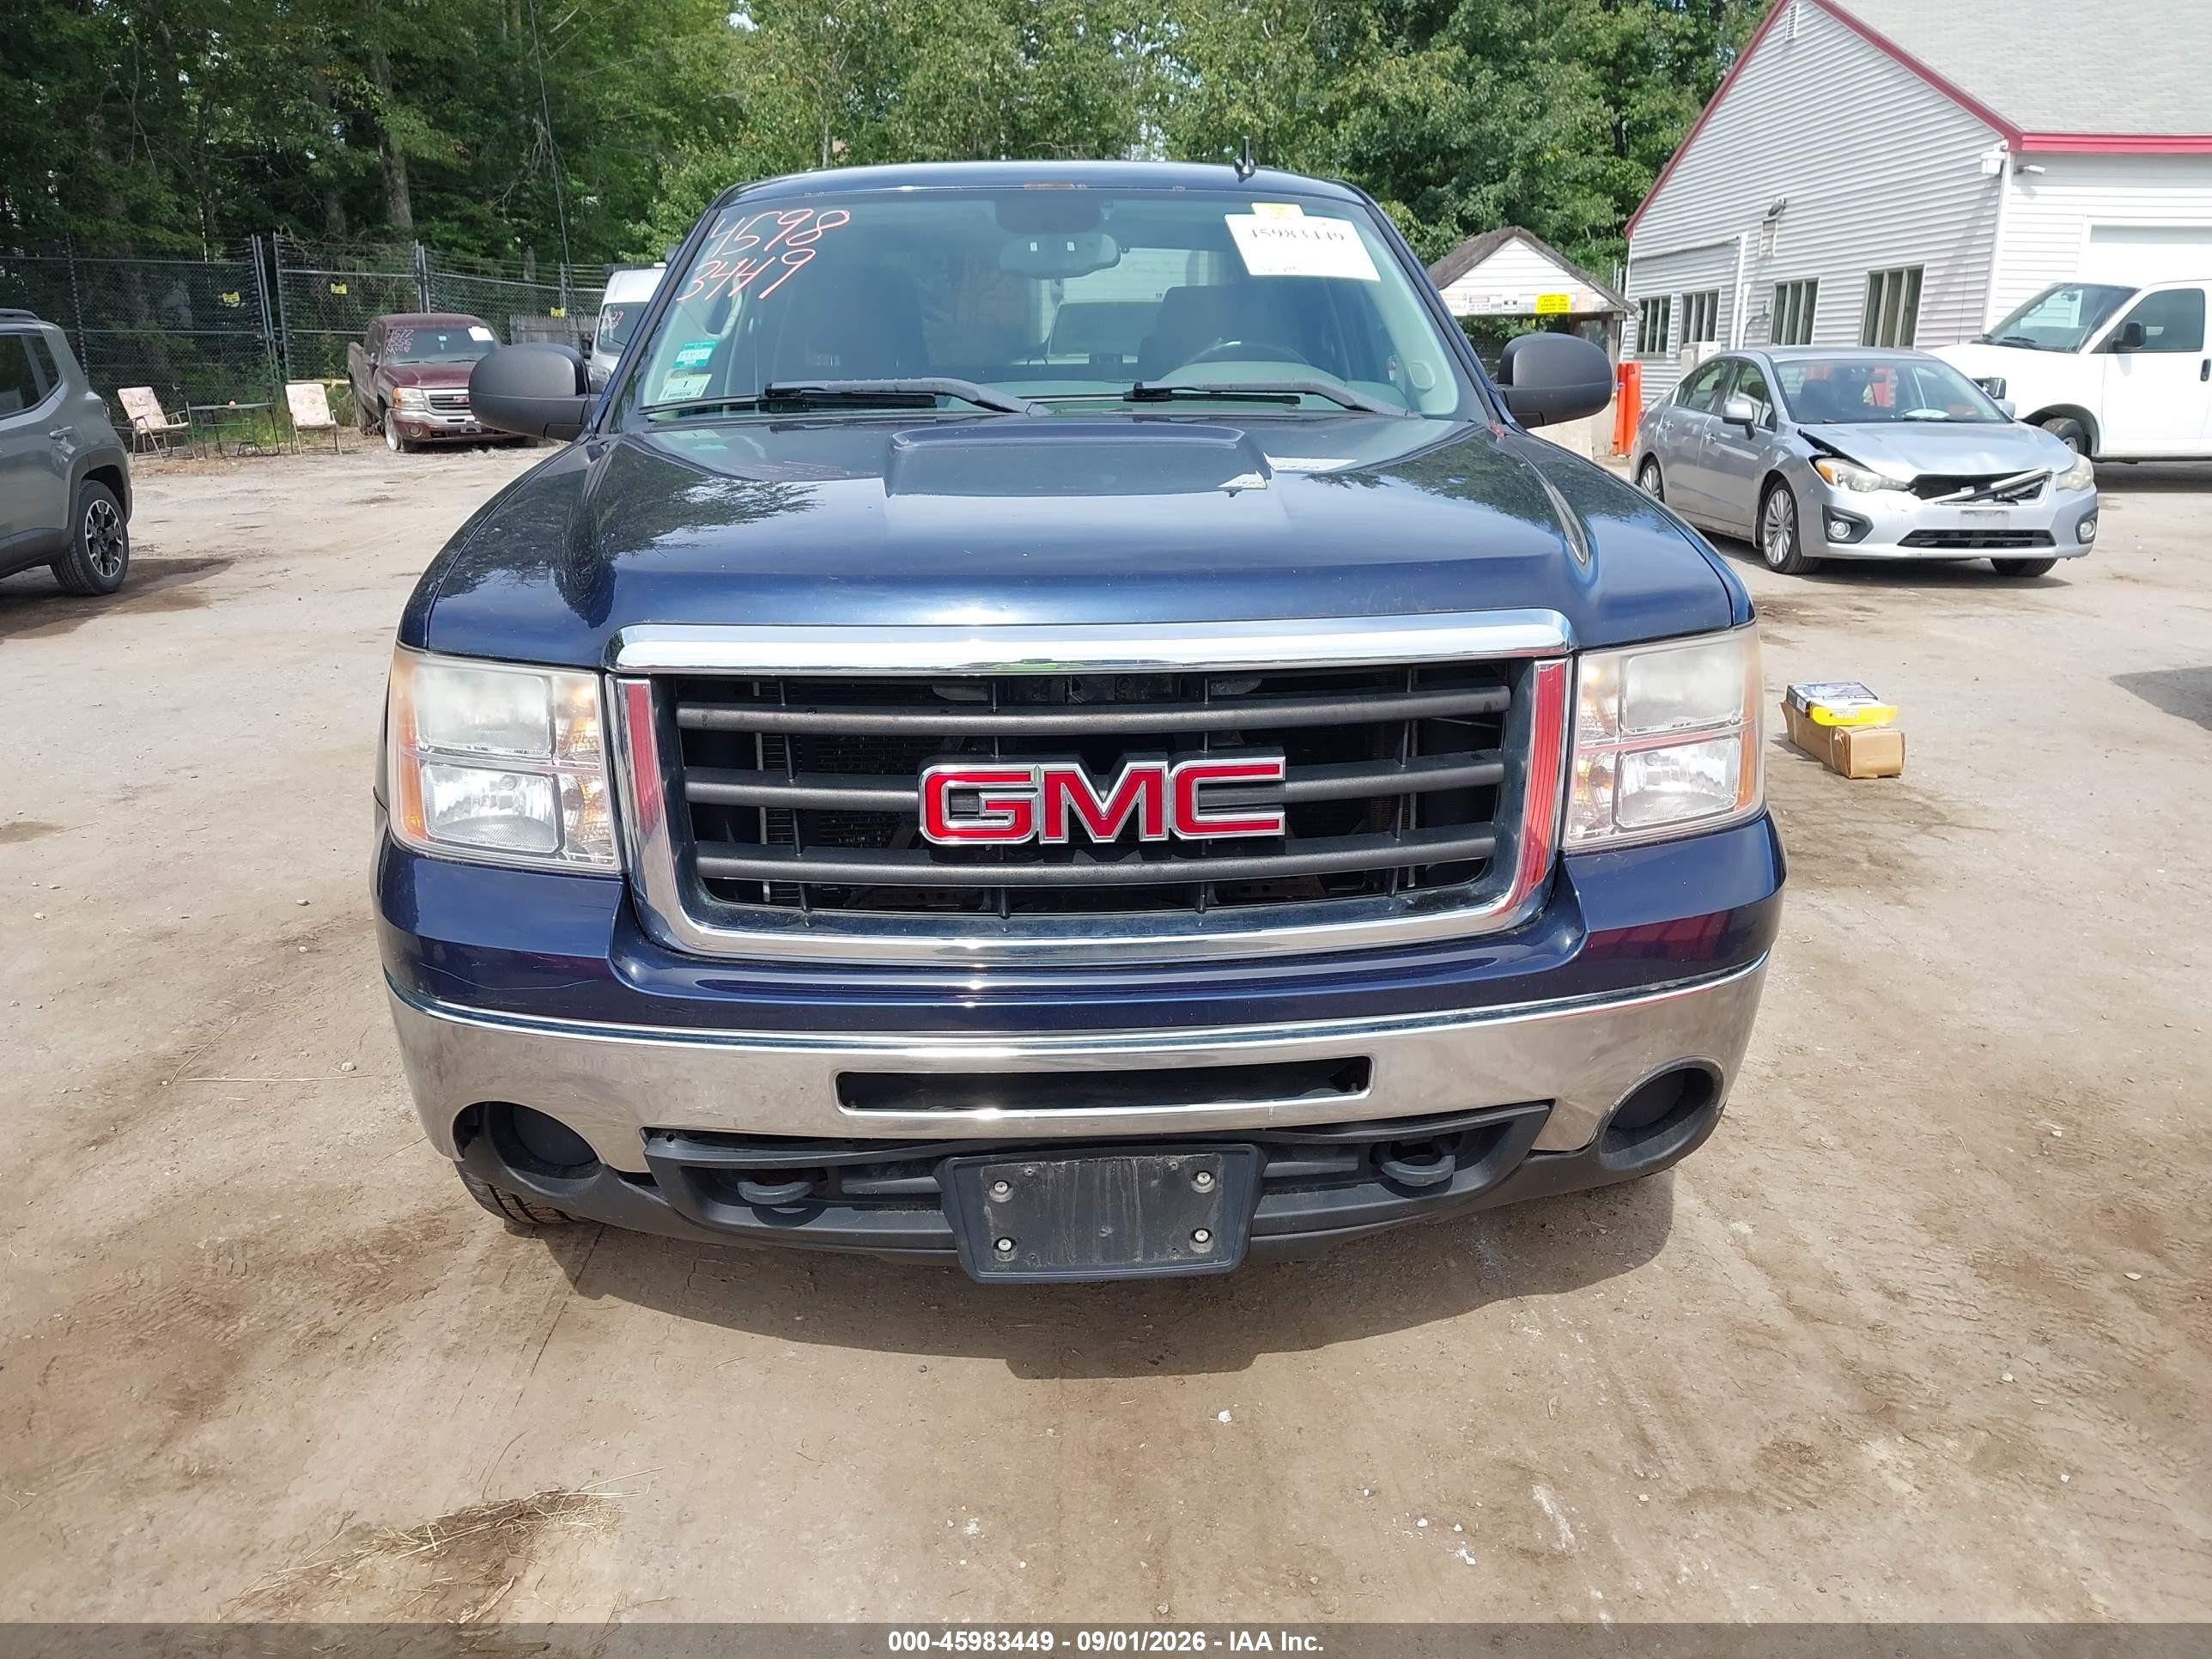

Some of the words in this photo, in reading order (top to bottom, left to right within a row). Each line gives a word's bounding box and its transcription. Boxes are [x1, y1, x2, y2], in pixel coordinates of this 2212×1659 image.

[709, 208, 851, 258] 4598
[676, 248, 817, 302] 3449
[919, 757, 1286, 846] GMC
